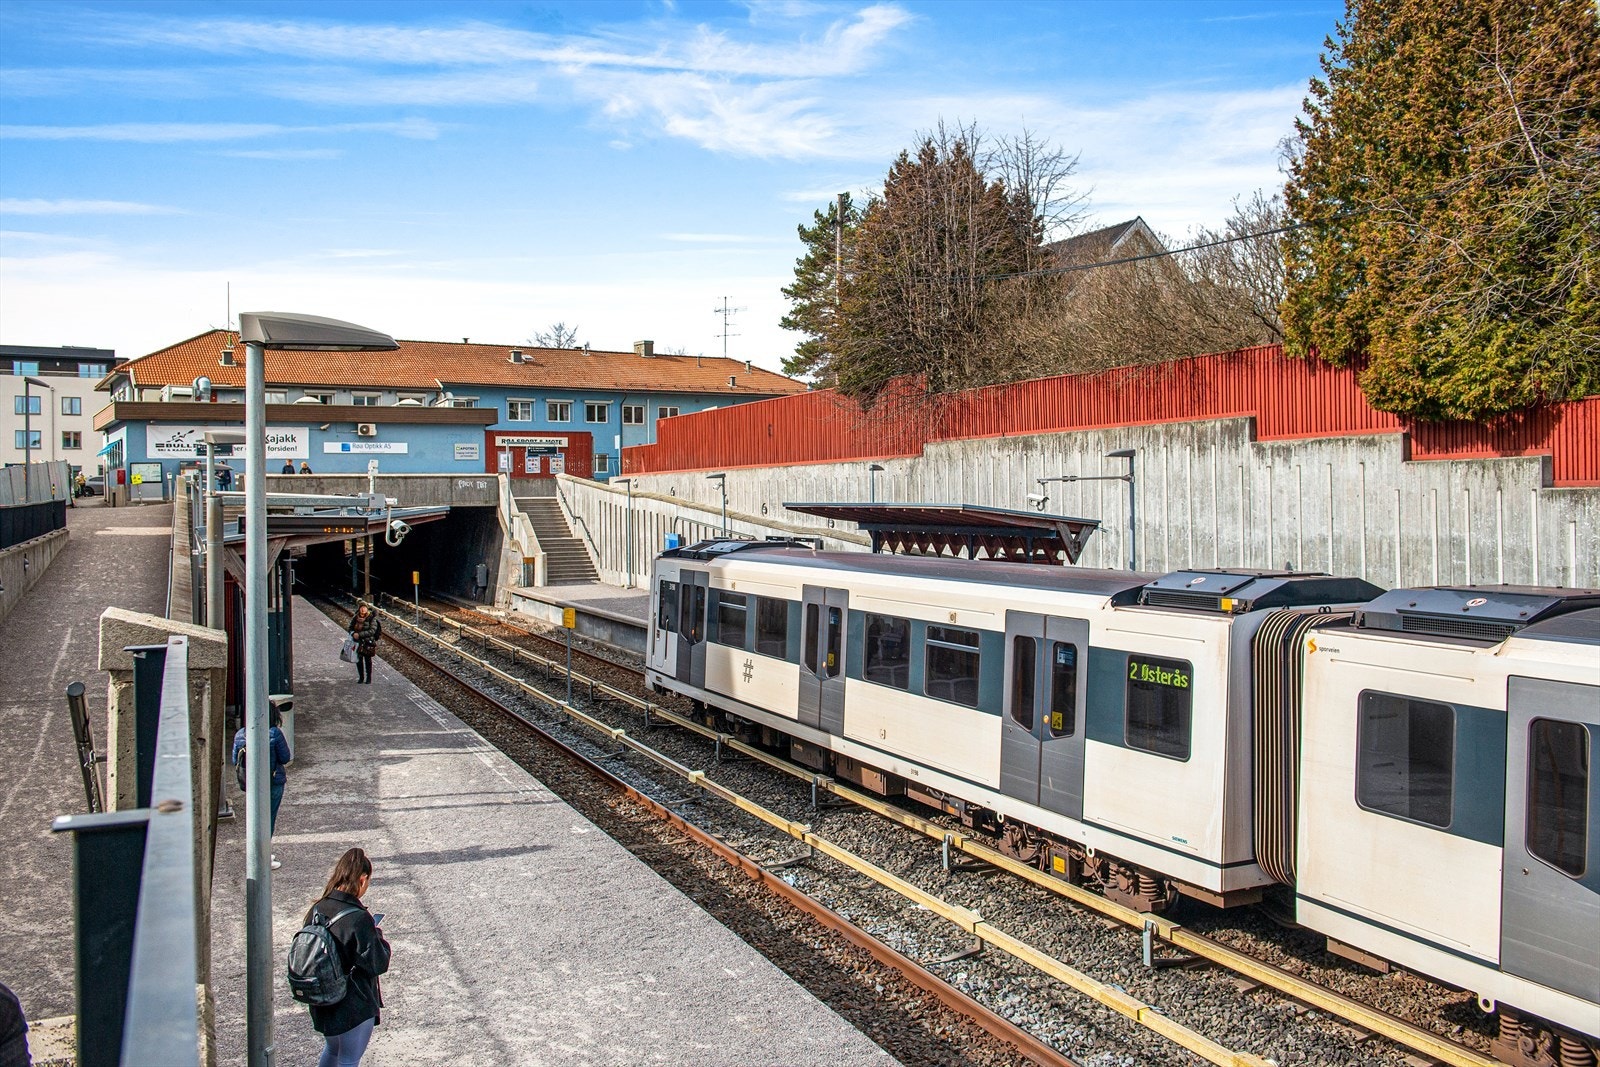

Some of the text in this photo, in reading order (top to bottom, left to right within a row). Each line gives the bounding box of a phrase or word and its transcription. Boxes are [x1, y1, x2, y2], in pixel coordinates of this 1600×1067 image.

[364, 442, 383, 450] Optikk
[1319, 646, 1341, 654] sporveien
[1129, 662, 1189, 688] 2 Østerås
